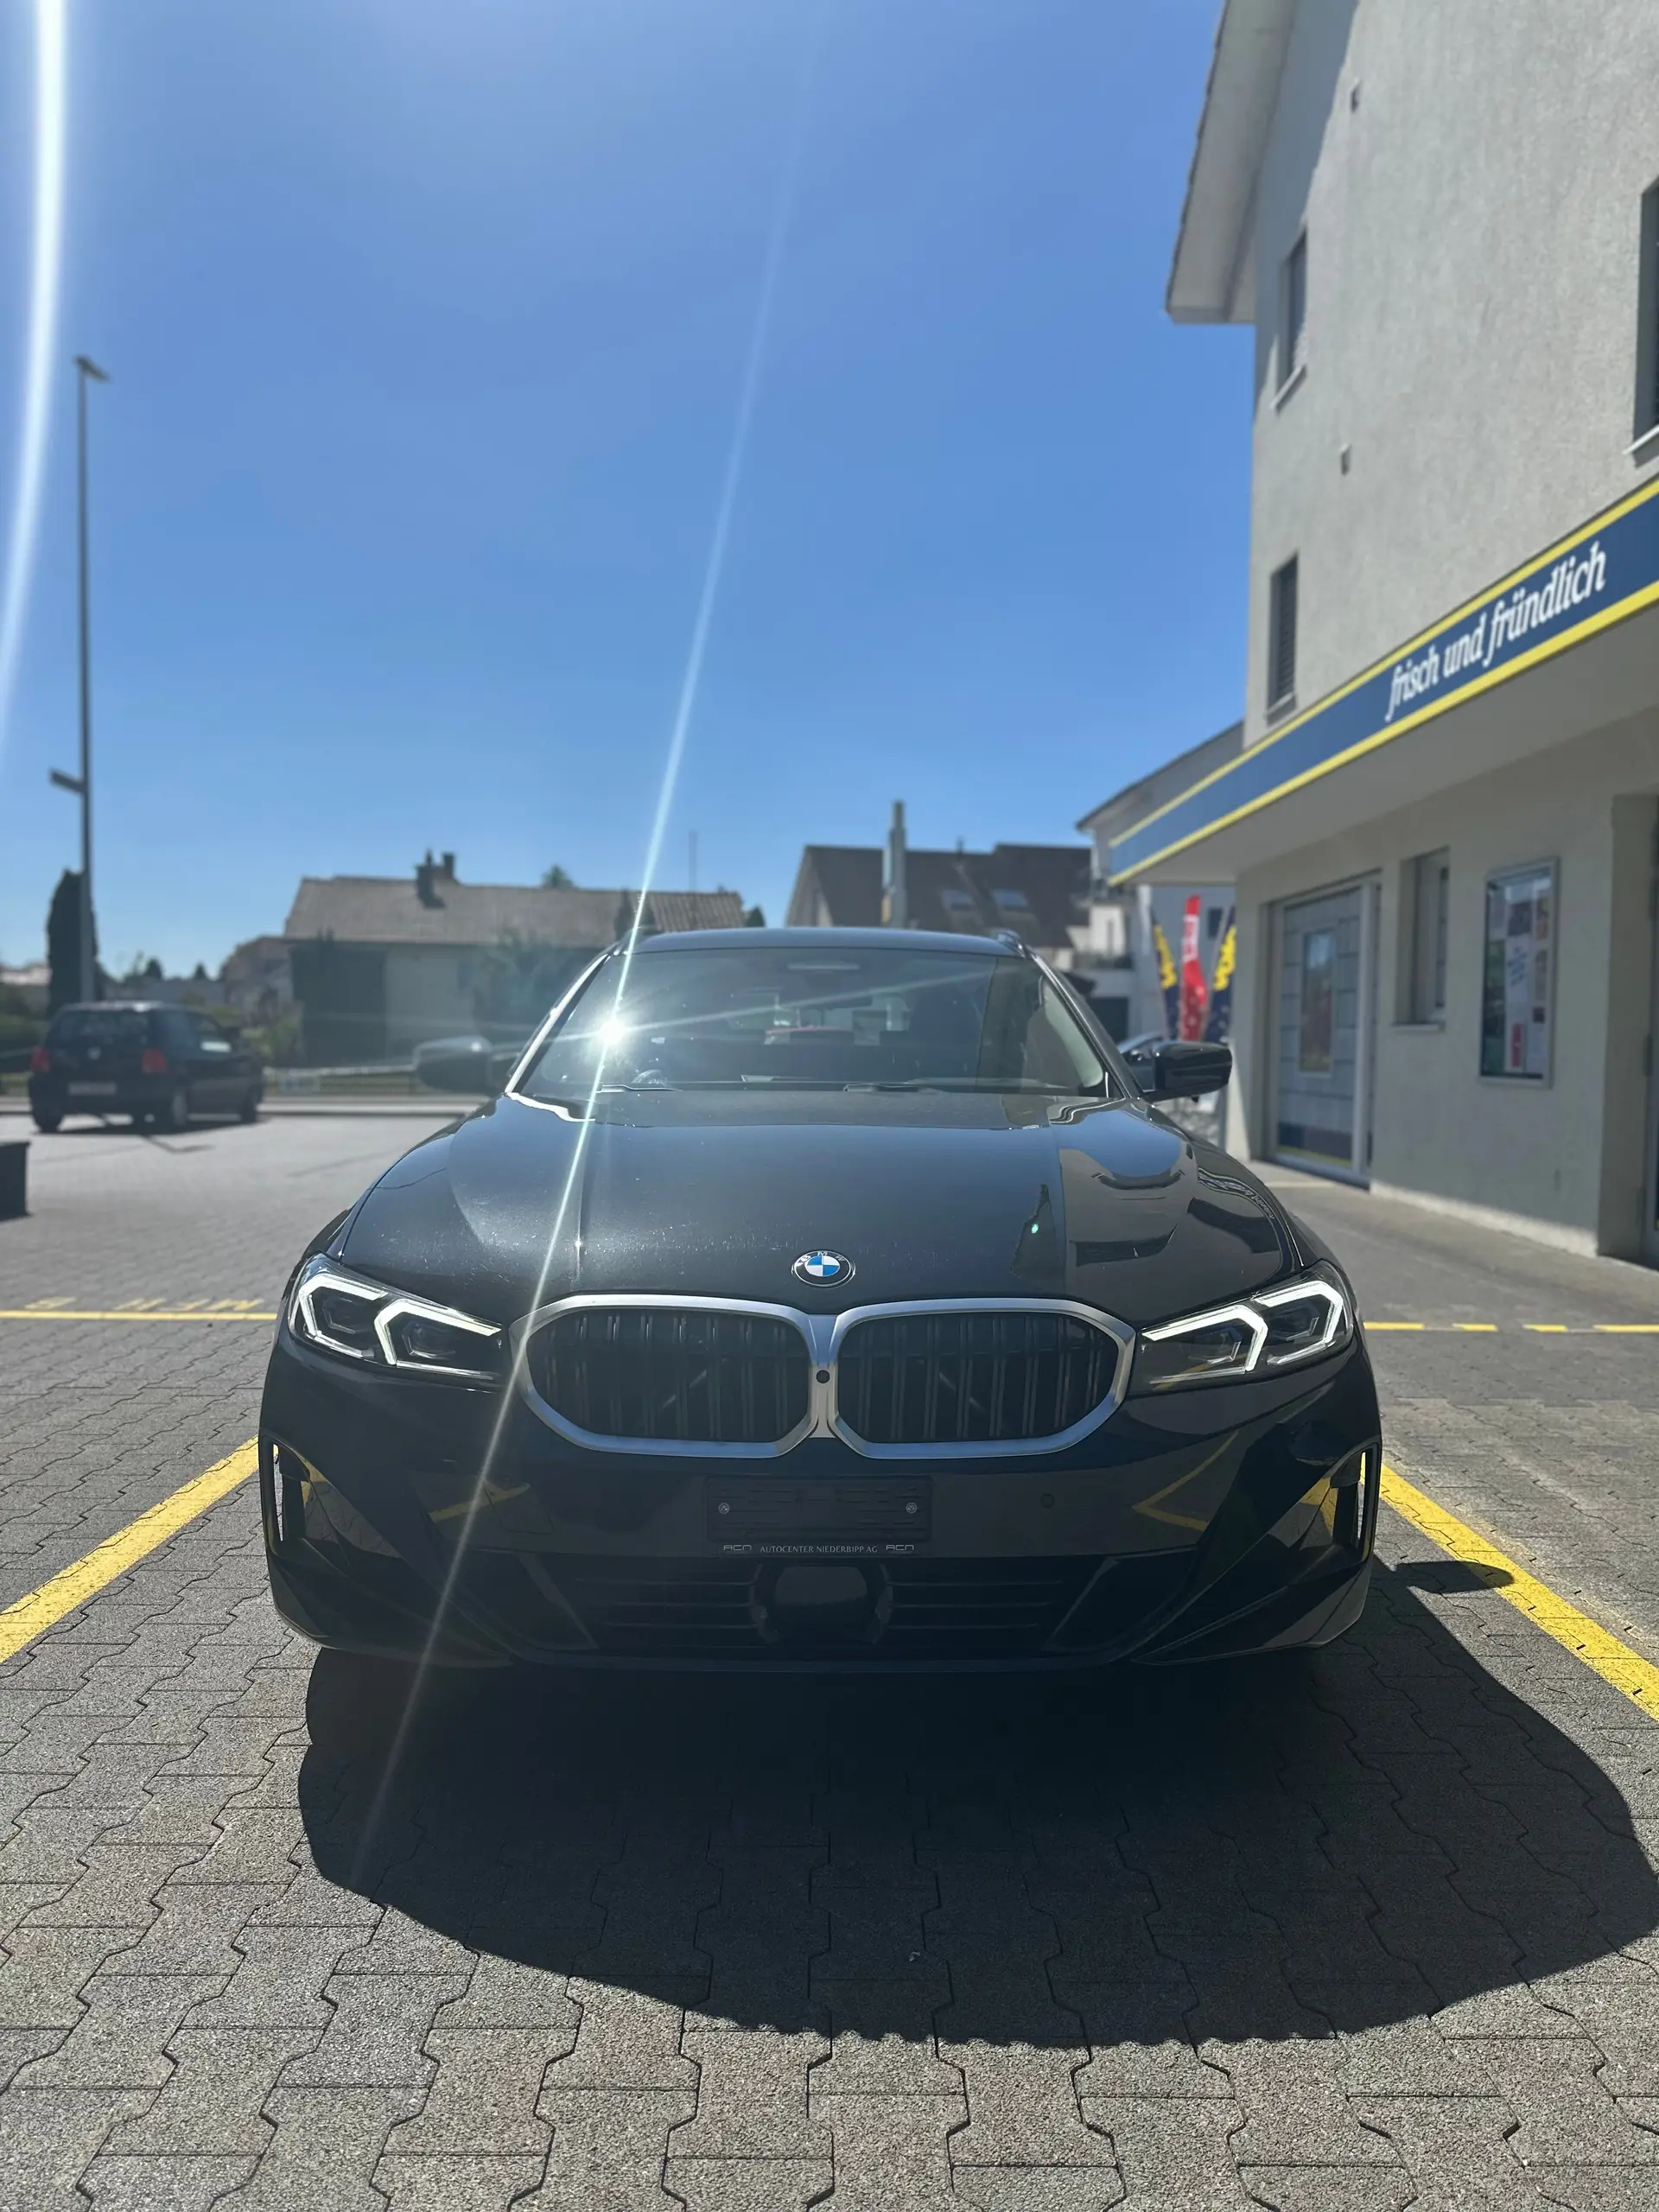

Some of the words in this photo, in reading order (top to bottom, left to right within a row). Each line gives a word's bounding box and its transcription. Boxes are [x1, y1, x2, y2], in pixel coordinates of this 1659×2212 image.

[1384, 645, 1440, 722] frisch
[1443, 610, 1486, 678] und
[1482, 540, 1607, 668] fründlich
[760, 1545, 814, 1554] AUTOCENTER
[816, 1545, 865, 1554] NIEDERBIPP
[866, 1545, 878, 1554] AG
